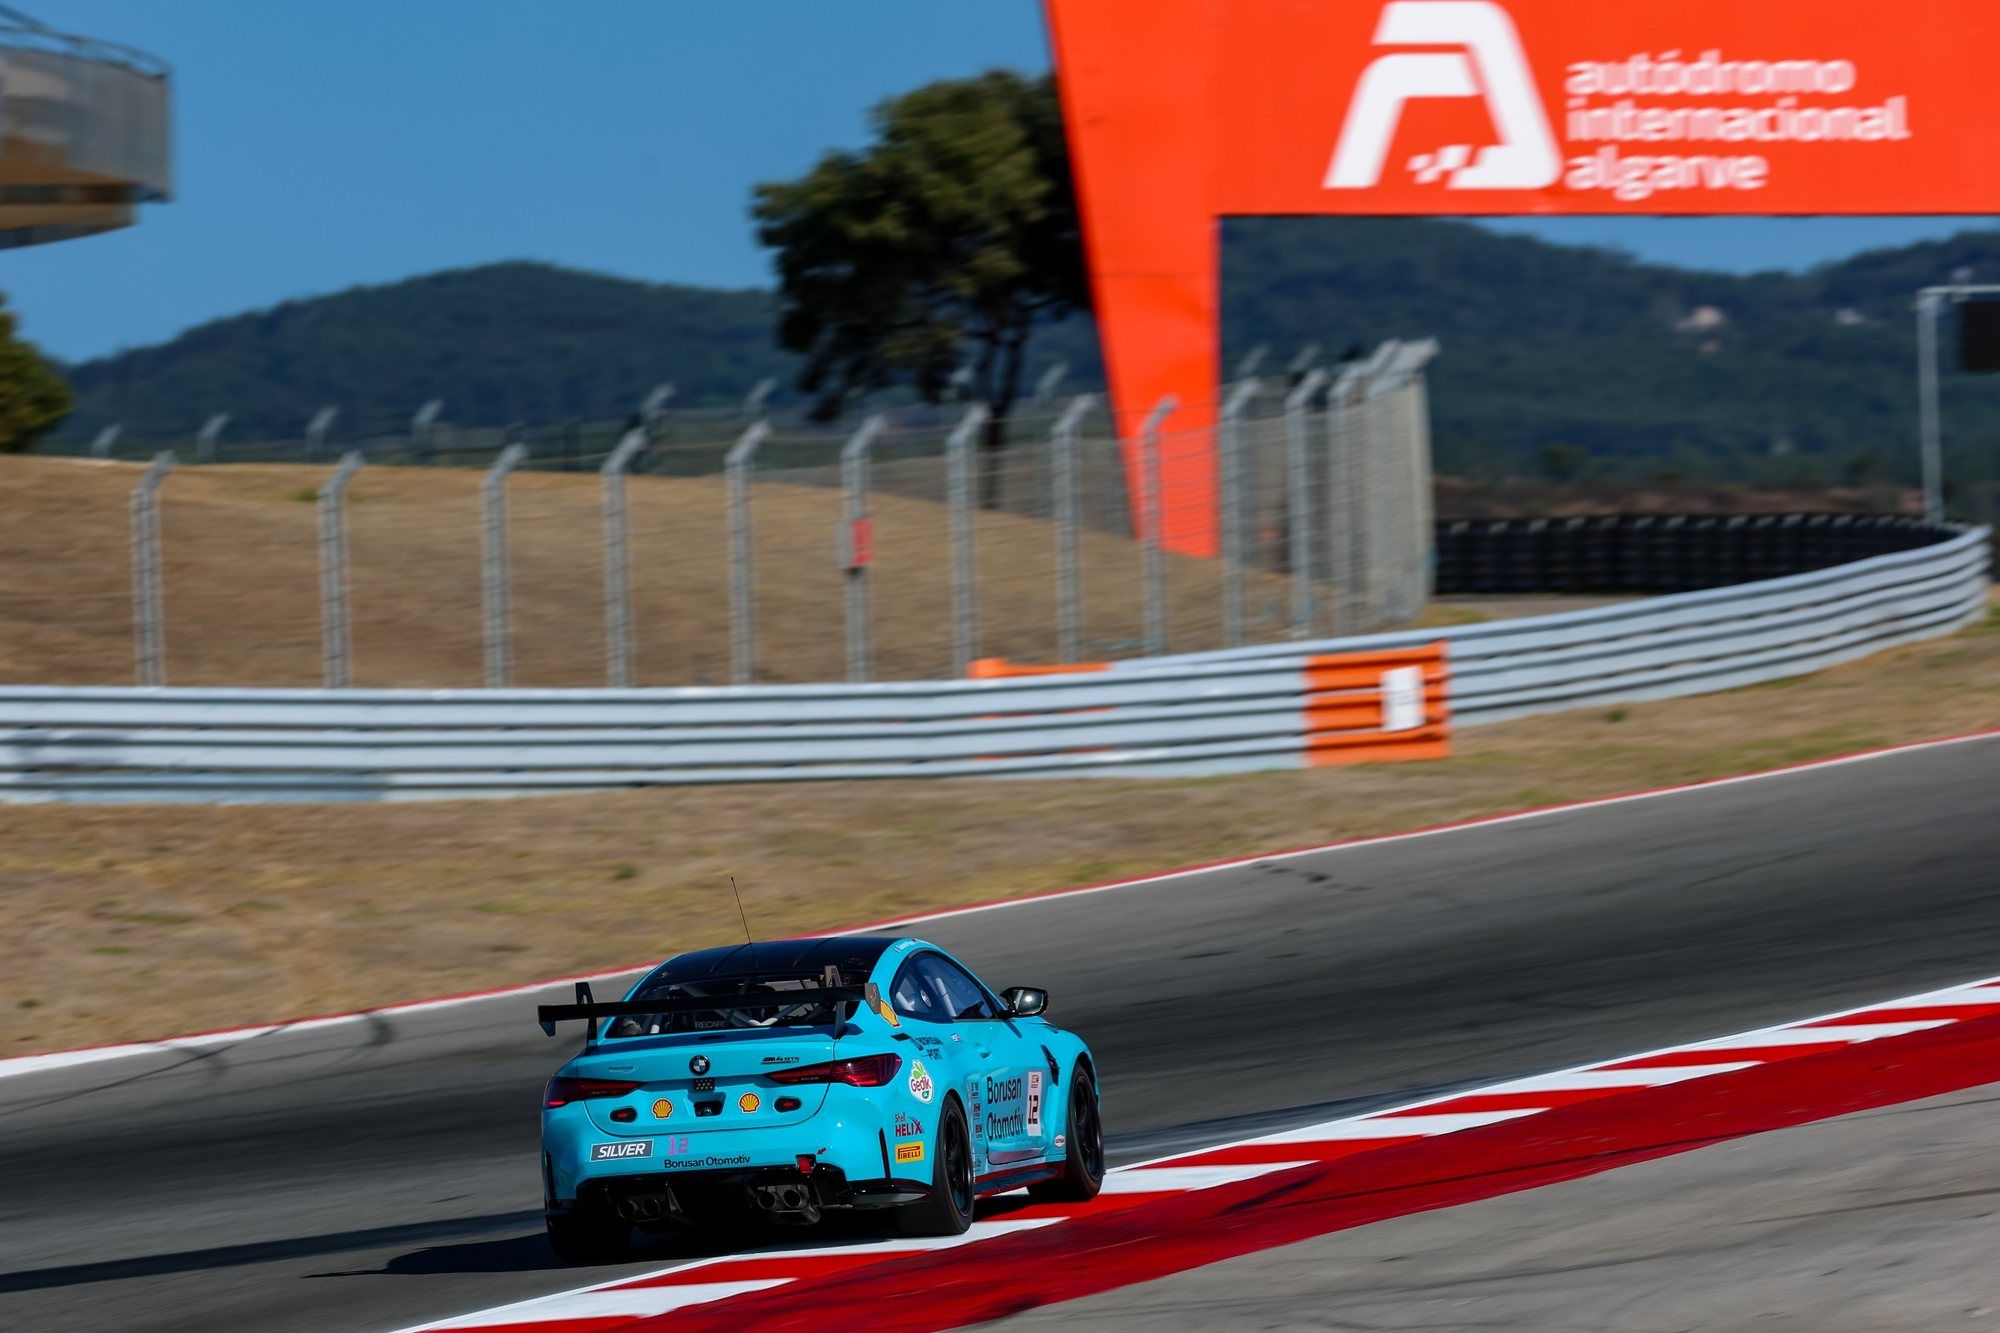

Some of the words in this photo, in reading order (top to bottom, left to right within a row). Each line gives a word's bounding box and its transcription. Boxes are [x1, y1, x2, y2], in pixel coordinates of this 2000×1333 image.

[1566, 49, 1855, 94] autódromo
[1566, 96, 1910, 141] internacional
[1565, 145, 1768, 200] algarve
[987, 1076, 1021, 1105] Borusan
[1027, 1095, 1039, 1124] 12
[895, 1120, 924, 1137] HELIX
[987, 1109, 1024, 1141] Otomotiv
[598, 1142, 646, 1158] SILVER
[668, 1136, 688, 1155] 12
[897, 1146, 921, 1159] PIRELLI
[664, 1158, 704, 1168] Borusan
[706, 1155, 751, 1166] Otomotiv
